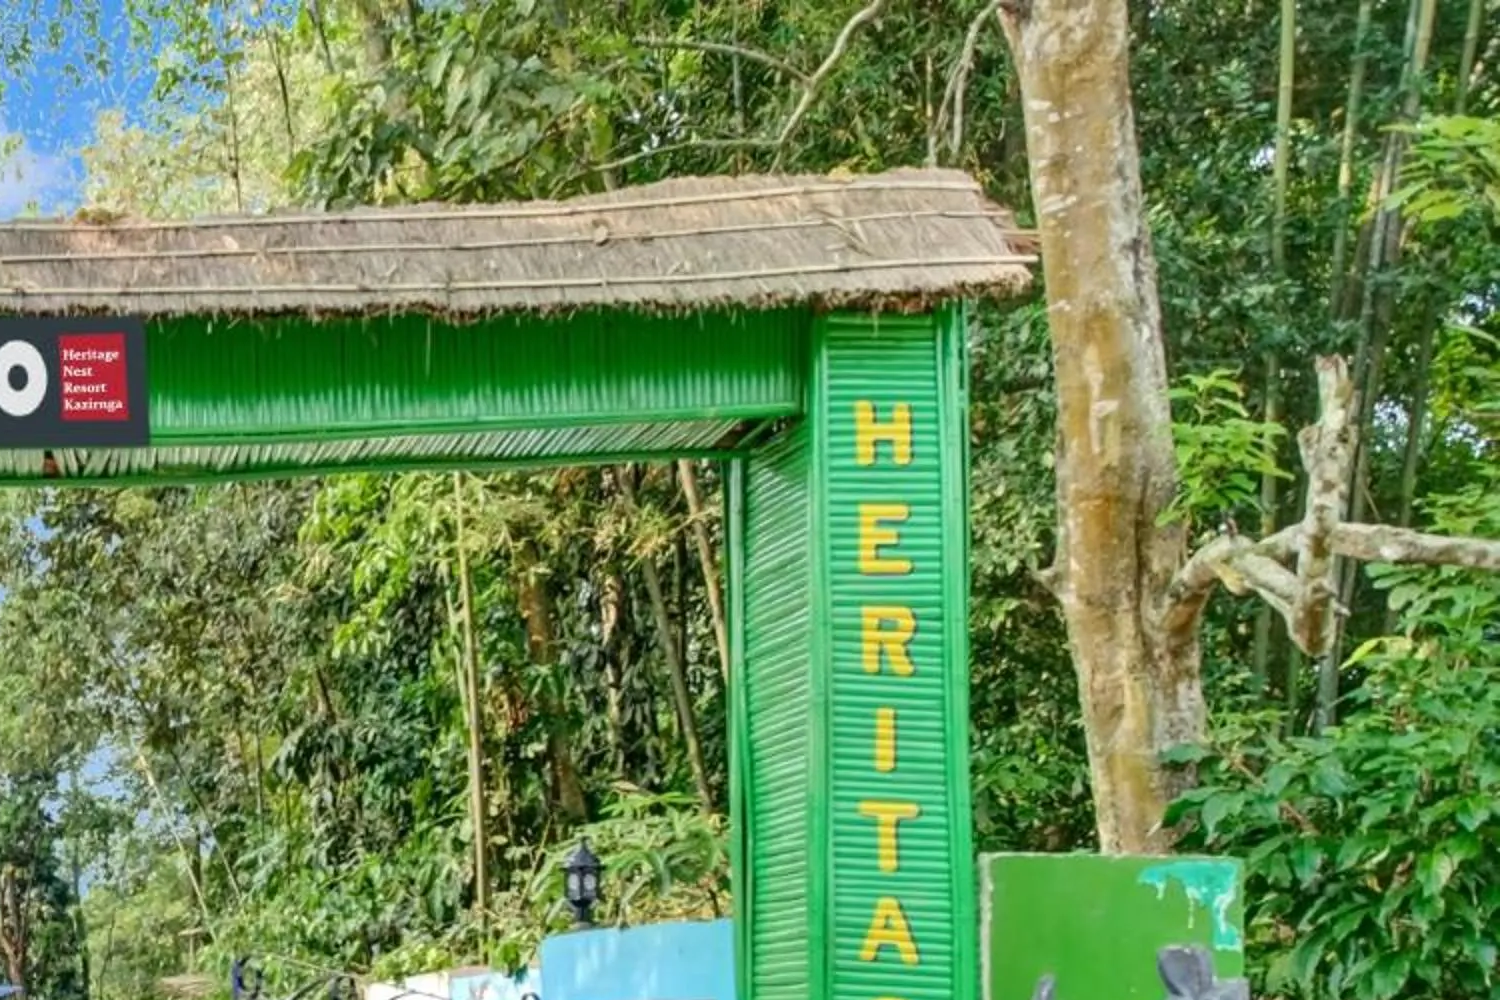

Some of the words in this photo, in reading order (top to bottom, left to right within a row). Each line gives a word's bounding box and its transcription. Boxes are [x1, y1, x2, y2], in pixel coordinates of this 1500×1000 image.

[62, 348, 120, 363] Heritage
[62, 365, 93, 377] Nest
[63, 382, 107, 394] Resort
